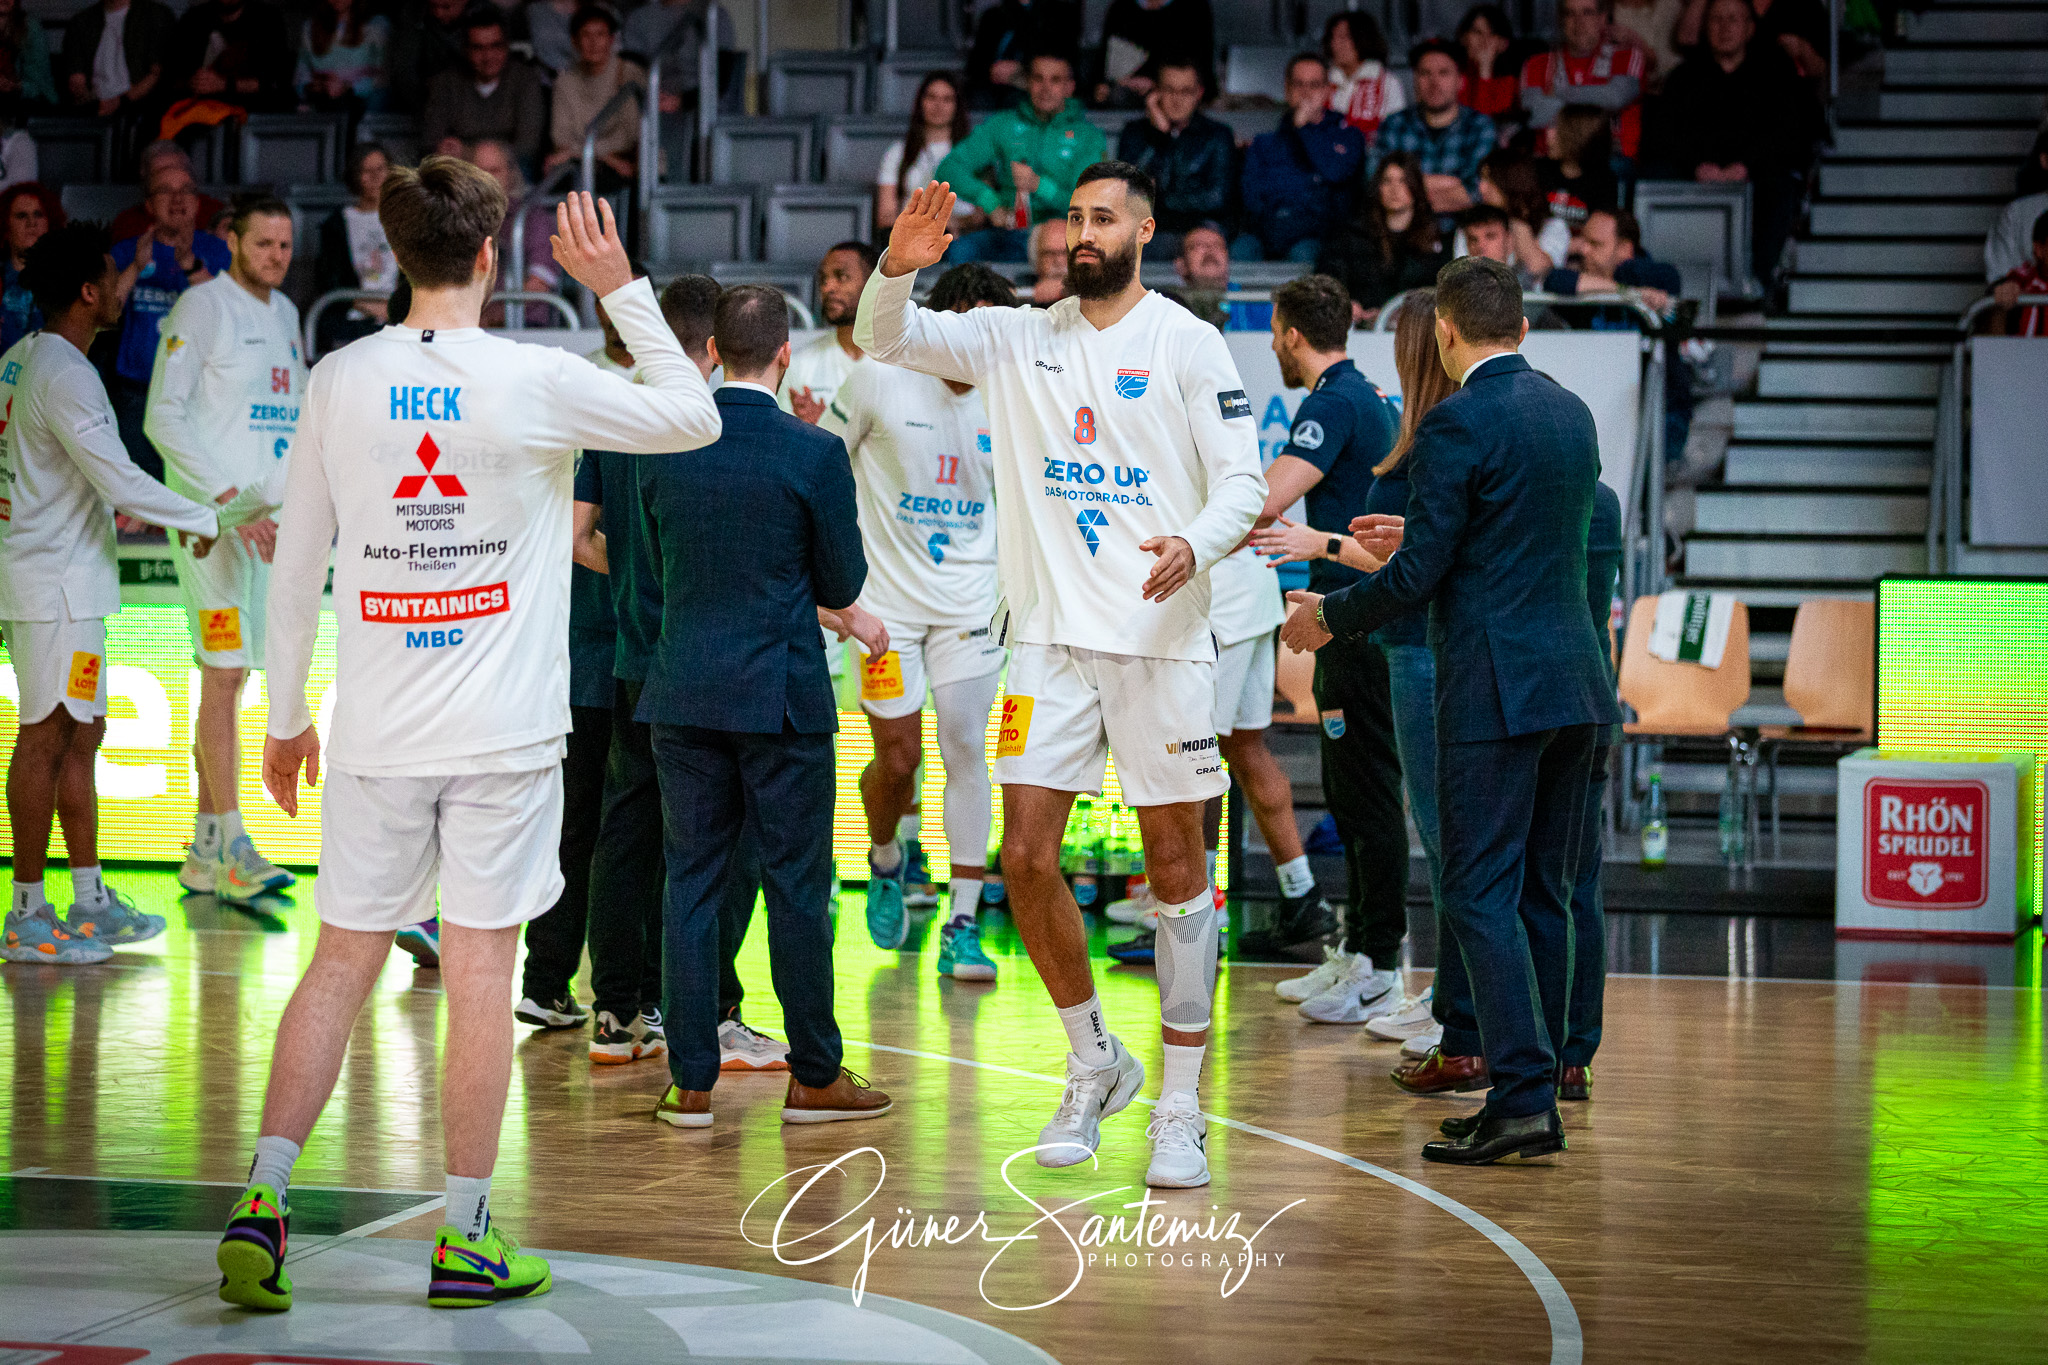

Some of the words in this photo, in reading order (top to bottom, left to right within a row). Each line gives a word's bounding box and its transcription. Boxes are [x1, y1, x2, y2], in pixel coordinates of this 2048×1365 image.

[271, 367, 290, 394] 54
[250, 403, 287, 421] ZERO
[390, 386, 461, 421] HECK
[1074, 406, 1097, 445] 8
[936, 455, 959, 485] 11
[1044, 456, 1105, 485] ZERO
[1114, 466, 1149, 488] UP
[396, 503, 465, 516] MITSUBISHI
[899, 491, 952, 515] ZERO
[957, 500, 985, 517] UP
[406, 518, 455, 532] MOTORS
[363, 539, 508, 560] Auto-Flemming
[408, 560, 457, 572] Theißen
[364, 588, 505, 618] SYNTAINICS
[406, 628, 464, 649] MBC
[1880, 795, 1974, 834] RHÖN
[1878, 832, 1975, 857] SPRUDEL
[1090, 1010, 1103, 1039] CRAFT
[474, 1194, 487, 1229] CRAFT
